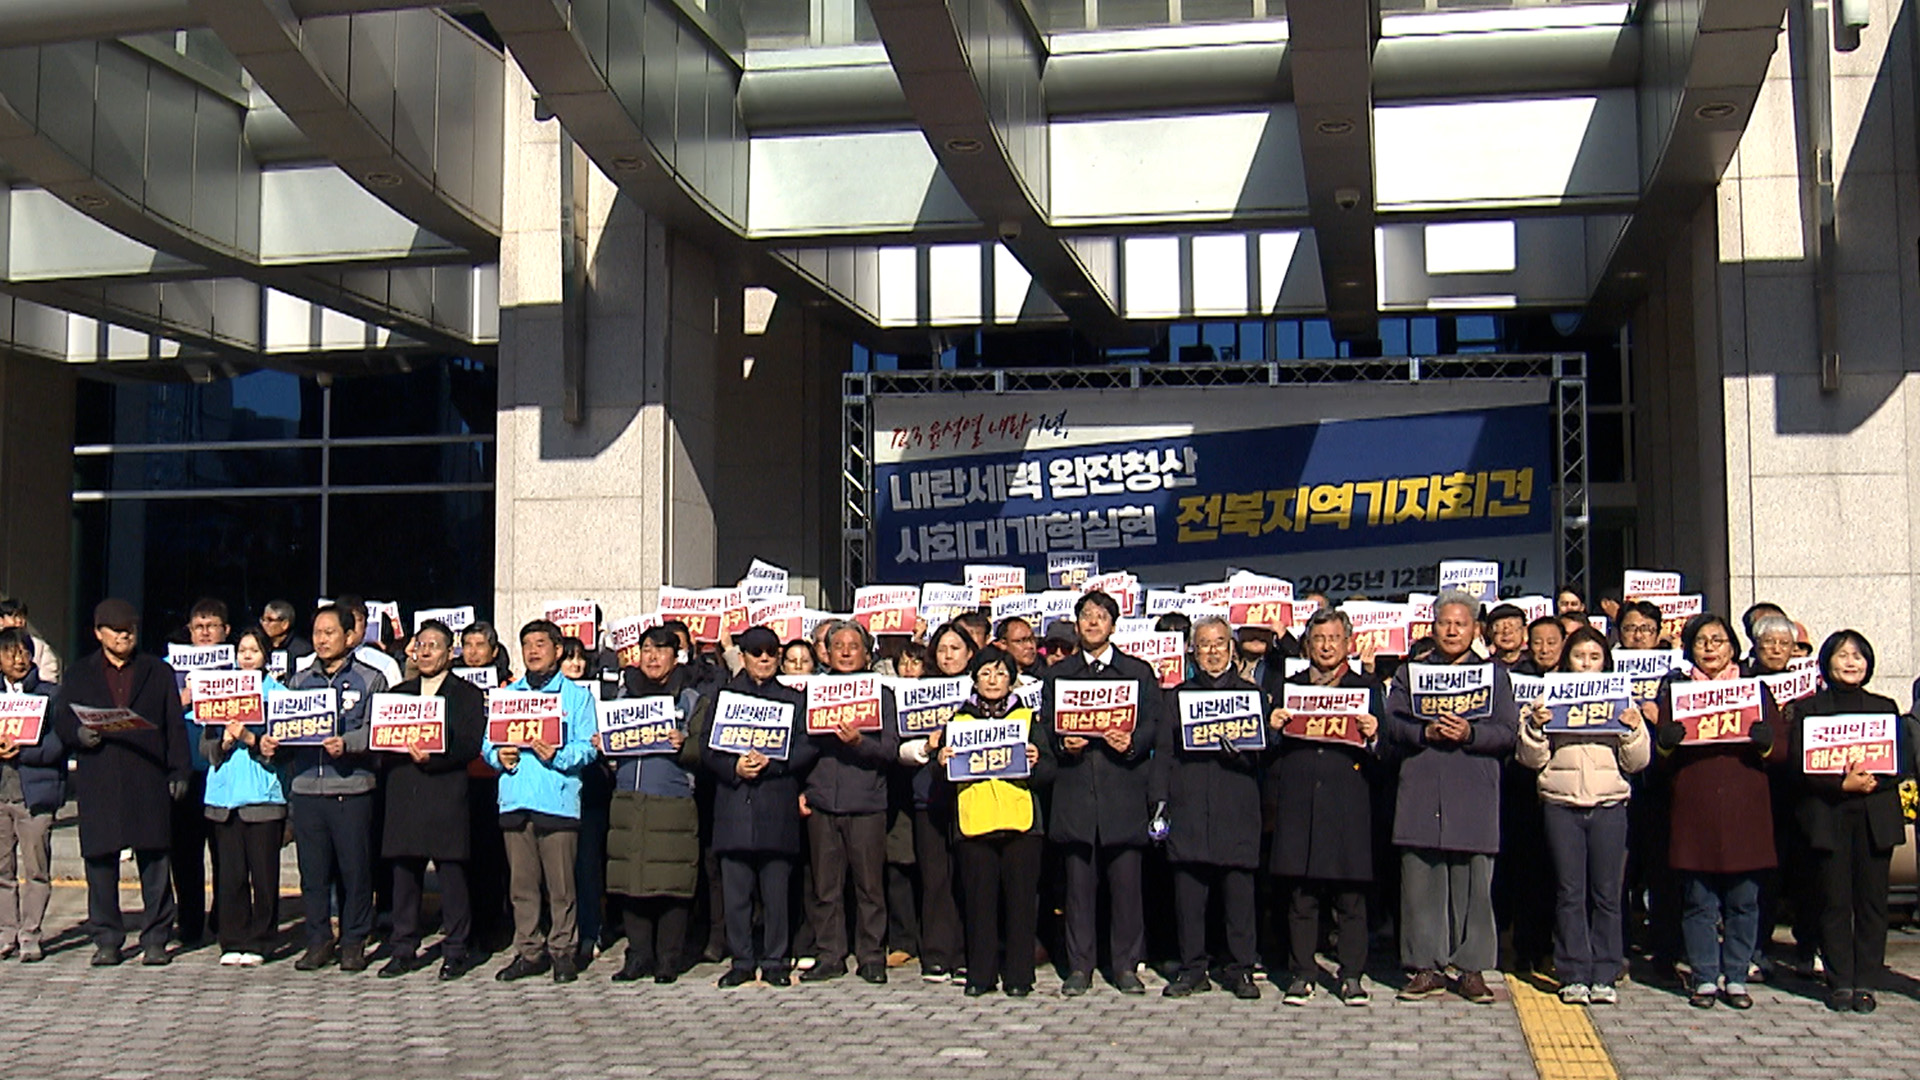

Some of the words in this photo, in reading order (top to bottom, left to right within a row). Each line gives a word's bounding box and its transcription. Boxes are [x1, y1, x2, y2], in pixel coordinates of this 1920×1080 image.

[928, 413, 984, 450] 윤석열
[988, 412, 1032, 440] 내란
[890, 461, 1043, 511] 내란세력
[1049, 447, 1198, 499] 완전청산
[1176, 467, 1534, 543] 전북지역기자회견
[895, 504, 1157, 565] 사회대개혁실현
[1300, 569, 1385, 593] 2025년
[1246, 602, 1281, 624] 설치
[199, 675, 255, 696] 국민의힘
[813, 678, 874, 702] 국민의힘
[1418, 668, 1483, 691] 내란세력
[273, 693, 327, 715] 내란세력
[904, 681, 961, 706] 내란세력
[1063, 685, 1131, 707] 국민의힘
[379, 702, 438, 721] 국민의힘
[1189, 695, 1250, 719] 내란세력
[1567, 701, 1616, 728] 실현!
[507, 719, 543, 743] 설치
[1305, 716, 1348, 738] 설치
[1697, 711, 1742, 740] 설치
[968, 747, 1012, 774] 실현!
